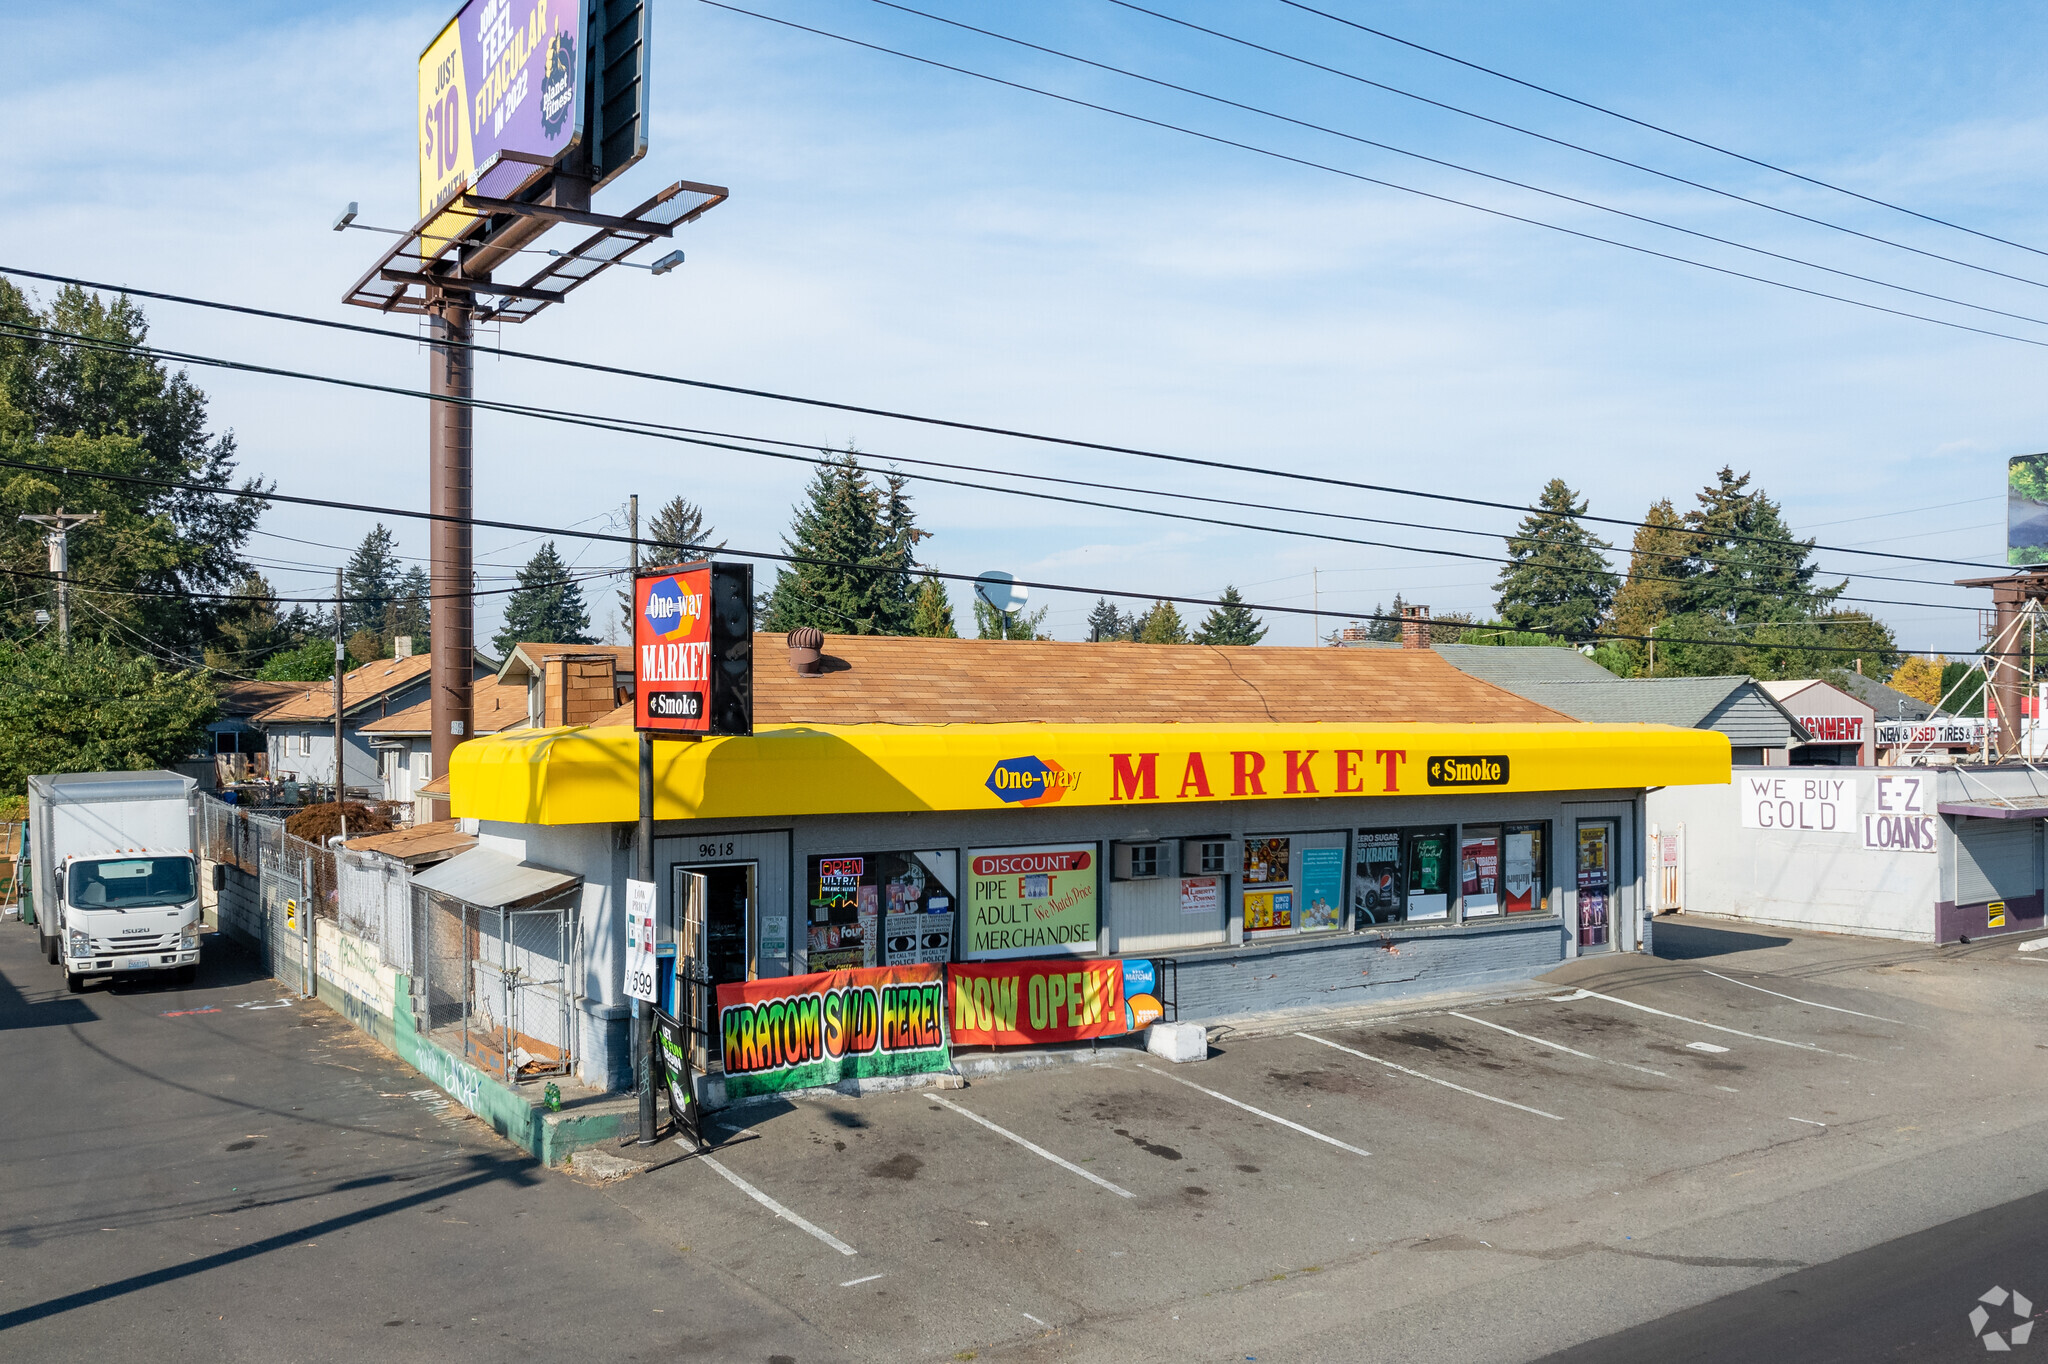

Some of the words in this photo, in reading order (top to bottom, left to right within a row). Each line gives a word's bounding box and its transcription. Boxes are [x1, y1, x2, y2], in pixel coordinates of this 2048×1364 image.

[483, 1, 514, 80] FEEL
[435, 49, 457, 96] JUST
[475, 0, 547, 136] FITACULAR
[494, 104, 504, 140] IN
[505, 68, 529, 124] 2022
[543, 72, 568, 112] planet
[545, 87, 572, 121] fitness
[425, 85, 459, 181] $10
[650, 593, 703, 621] One-way
[641, 641, 710, 682] MARKET
[657, 694, 698, 715] Smoke
[1879, 727, 1901, 743] NEW
[1902, 728, 1909, 741] &
[1910, 726, 1936, 743] USED
[1938, 726, 1965, 742] TIRES
[1965, 728, 1971, 741] &
[995, 766, 1082, 791] One-way
[1109, 749, 1407, 801] MARKET
[1444, 758, 1501, 782] Smoke
[1751, 778, 1786, 798] WE
[1804, 780, 1844, 801] BUY
[1877, 778, 1921, 812] E-Z
[1758, 800, 1836, 831] GOLD
[1865, 816, 1934, 850] LOANS
[699, 842, 734, 857] 9618
[1366, 847, 1398, 863] KRAKEN
[822, 859, 862, 876] OPEN
[982, 855, 1070, 874] DISCOUNT
[975, 879, 1008, 901] PIPE
[1018, 875, 1058, 899] ET
[1507, 874, 1530, 890] Marlboro
[632, 900, 648, 913] PRICE
[976, 903, 1033, 926] ADULT
[1034, 905, 1050, 921] We
[1048, 892, 1074, 915] Match
[1071, 884, 1092, 904] Price
[1409, 903, 1414, 911] $
[841, 925, 863, 939] four
[975, 924, 1090, 951] MERCHANDISE
[891, 958, 915, 966] POLICE
[923, 955, 946, 963] POLICE
[632, 971, 652, 995] 599
[955, 973, 1019, 1032] NOW
[1028, 966, 1116, 1031] OPEN!
[661, 1025, 671, 1041] LET
[725, 993, 822, 1072] KRATOM
[882, 983, 943, 1050] HERE!
[668, 1040, 683, 1060] FUN
